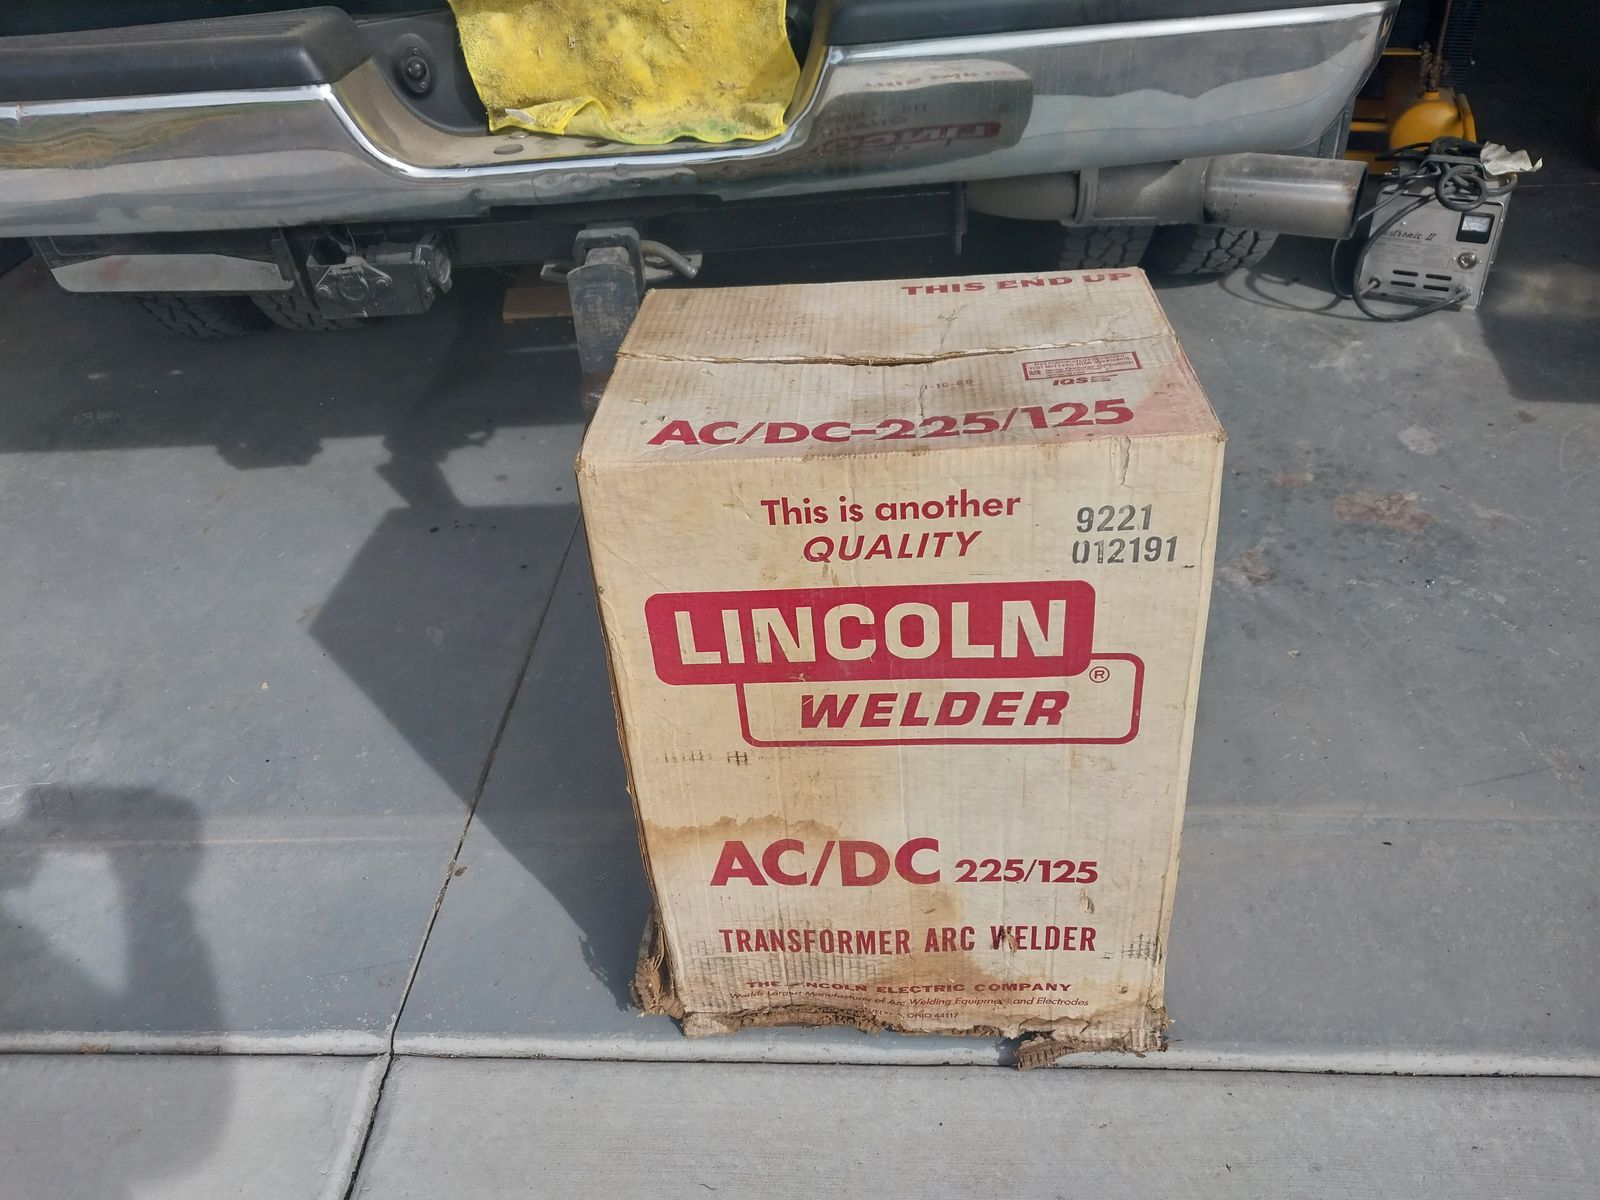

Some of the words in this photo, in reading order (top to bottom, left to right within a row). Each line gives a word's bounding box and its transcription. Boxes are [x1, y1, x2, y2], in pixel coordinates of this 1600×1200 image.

[901, 282, 985, 295] THIS
[996, 276, 1073, 289] END
[1082, 273, 1132, 283] UP
[760, 497, 829, 526] This
[839, 495, 864, 522] is
[875, 488, 1021, 521] another
[1077, 504, 1152, 533] 9221
[803, 530, 982, 563] QUALITY
[1072, 536, 1178, 564] 012191
[674, 599, 1067, 666] LINCOLN
[801, 690, 1070, 729] WELDER
[709, 837, 941, 887] AC/DC
[954, 858, 1099, 884] 225/125
[719, 928, 910, 955] TRANSFORMER
[925, 926, 975, 952] ARC
[990, 925, 1096, 952] WELDER
[785, 981, 867, 992] NCOLN
[876, 983, 965, 994] ELECTRIC
[974, 983, 1072, 992] COMPANY
[909, 998, 951, 1007] Welding
[954, 997, 1011, 1007] Equipme
[1012, 997, 1034, 1006] and
[1036, 997, 1089, 1006] Electrodes
